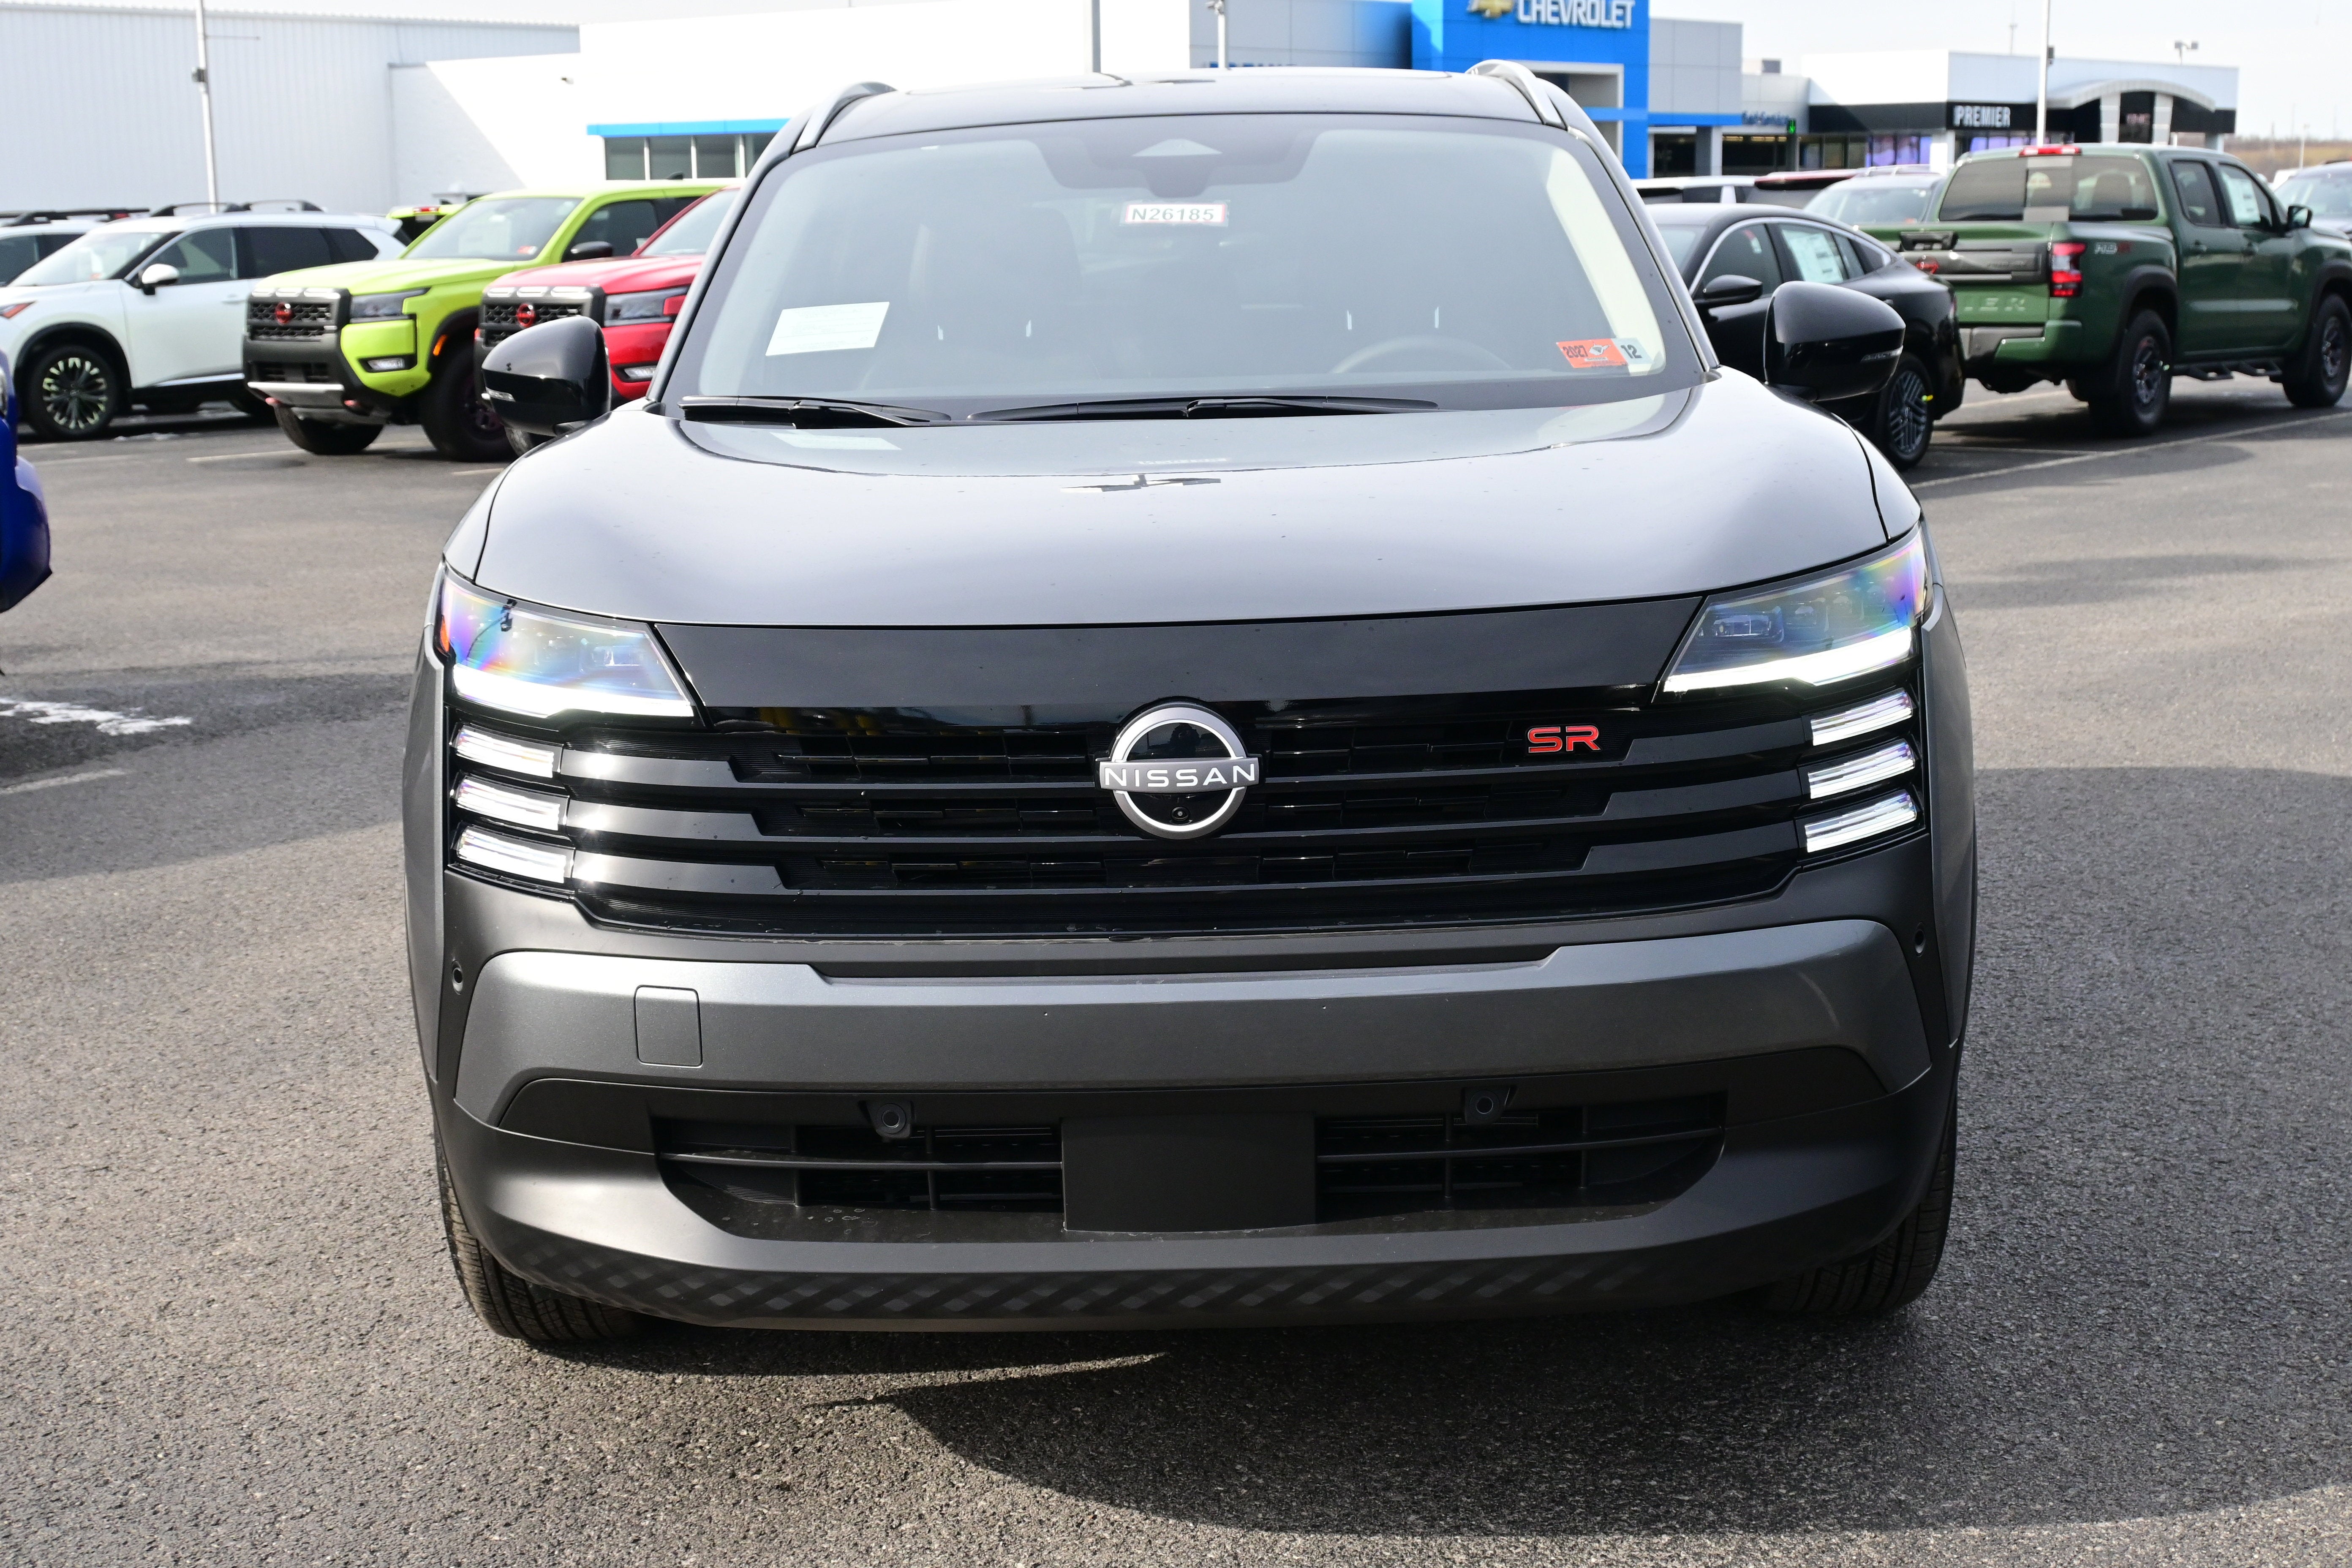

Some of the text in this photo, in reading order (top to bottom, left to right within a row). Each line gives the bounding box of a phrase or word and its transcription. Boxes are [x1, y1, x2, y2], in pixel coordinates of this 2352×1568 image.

[1517, 0, 1636, 29] CHEVROLET
[1953, 105, 2011, 128] PREMIER
[1132, 208, 1214, 220] N26185
[1563, 344, 1642, 359] 2027 12
[1527, 725, 1601, 753] SR
[1104, 763, 1255, 788] NISSAN
